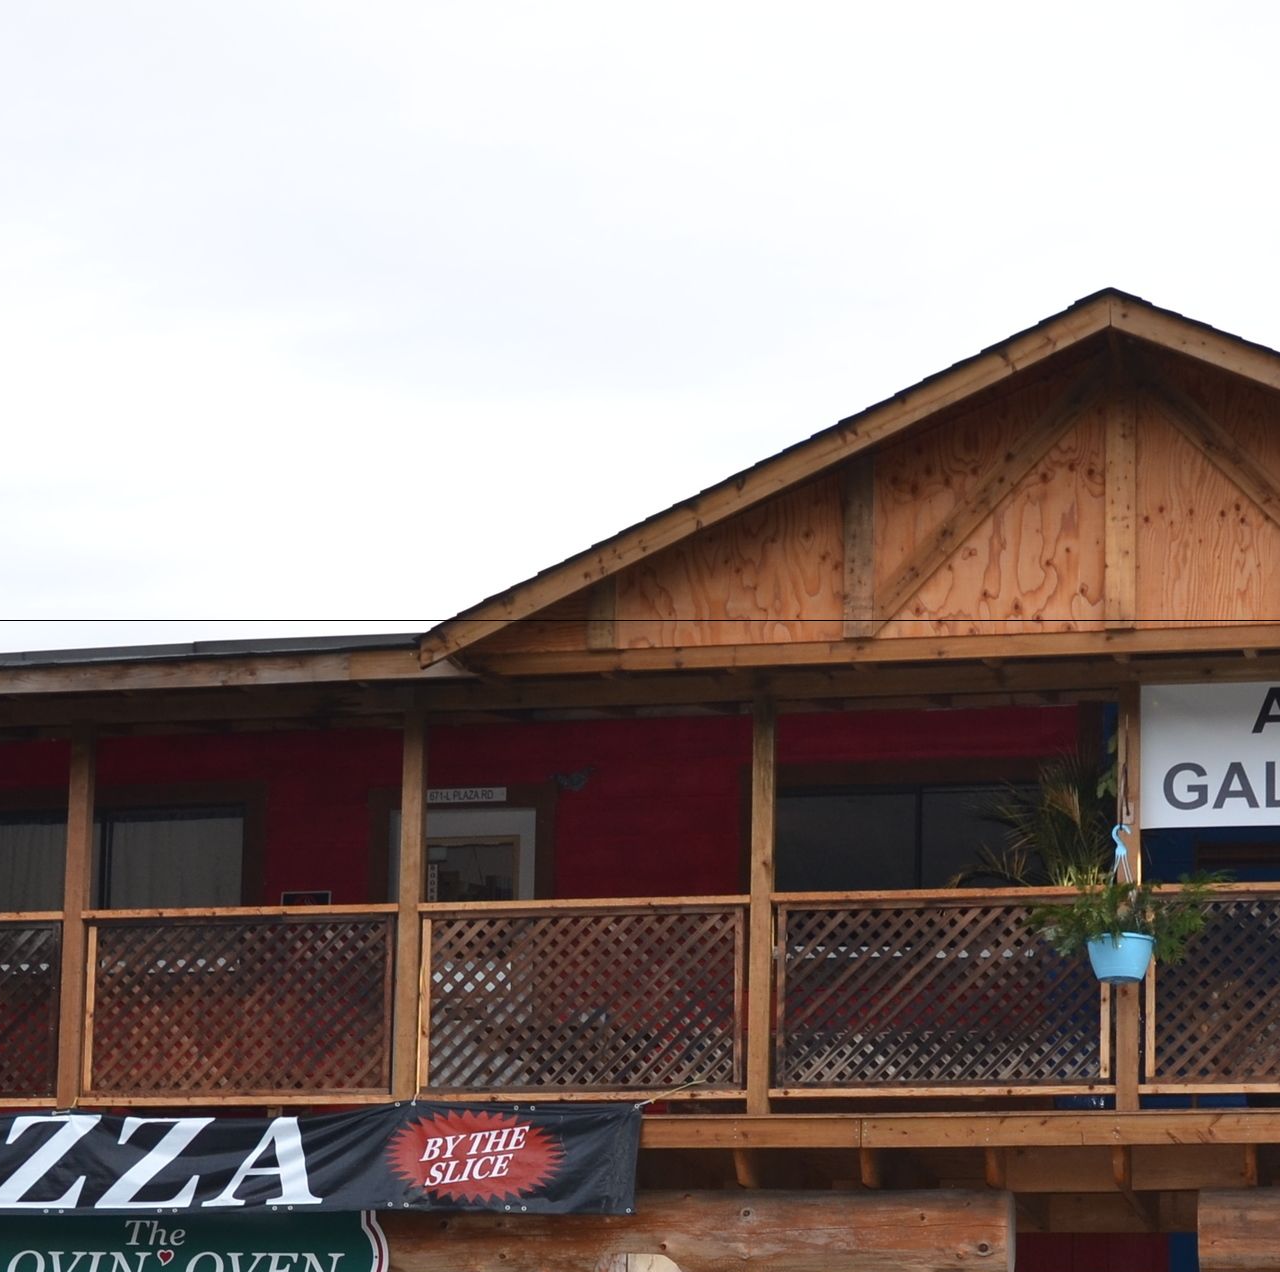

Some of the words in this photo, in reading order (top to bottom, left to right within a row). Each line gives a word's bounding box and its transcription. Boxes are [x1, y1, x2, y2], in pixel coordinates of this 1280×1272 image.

[419, 1134, 467, 1161] BY
[469, 1126, 530, 1155] THE
[424, 1153, 514, 1187] SLICE
[124, 1219, 186, 1247] The
